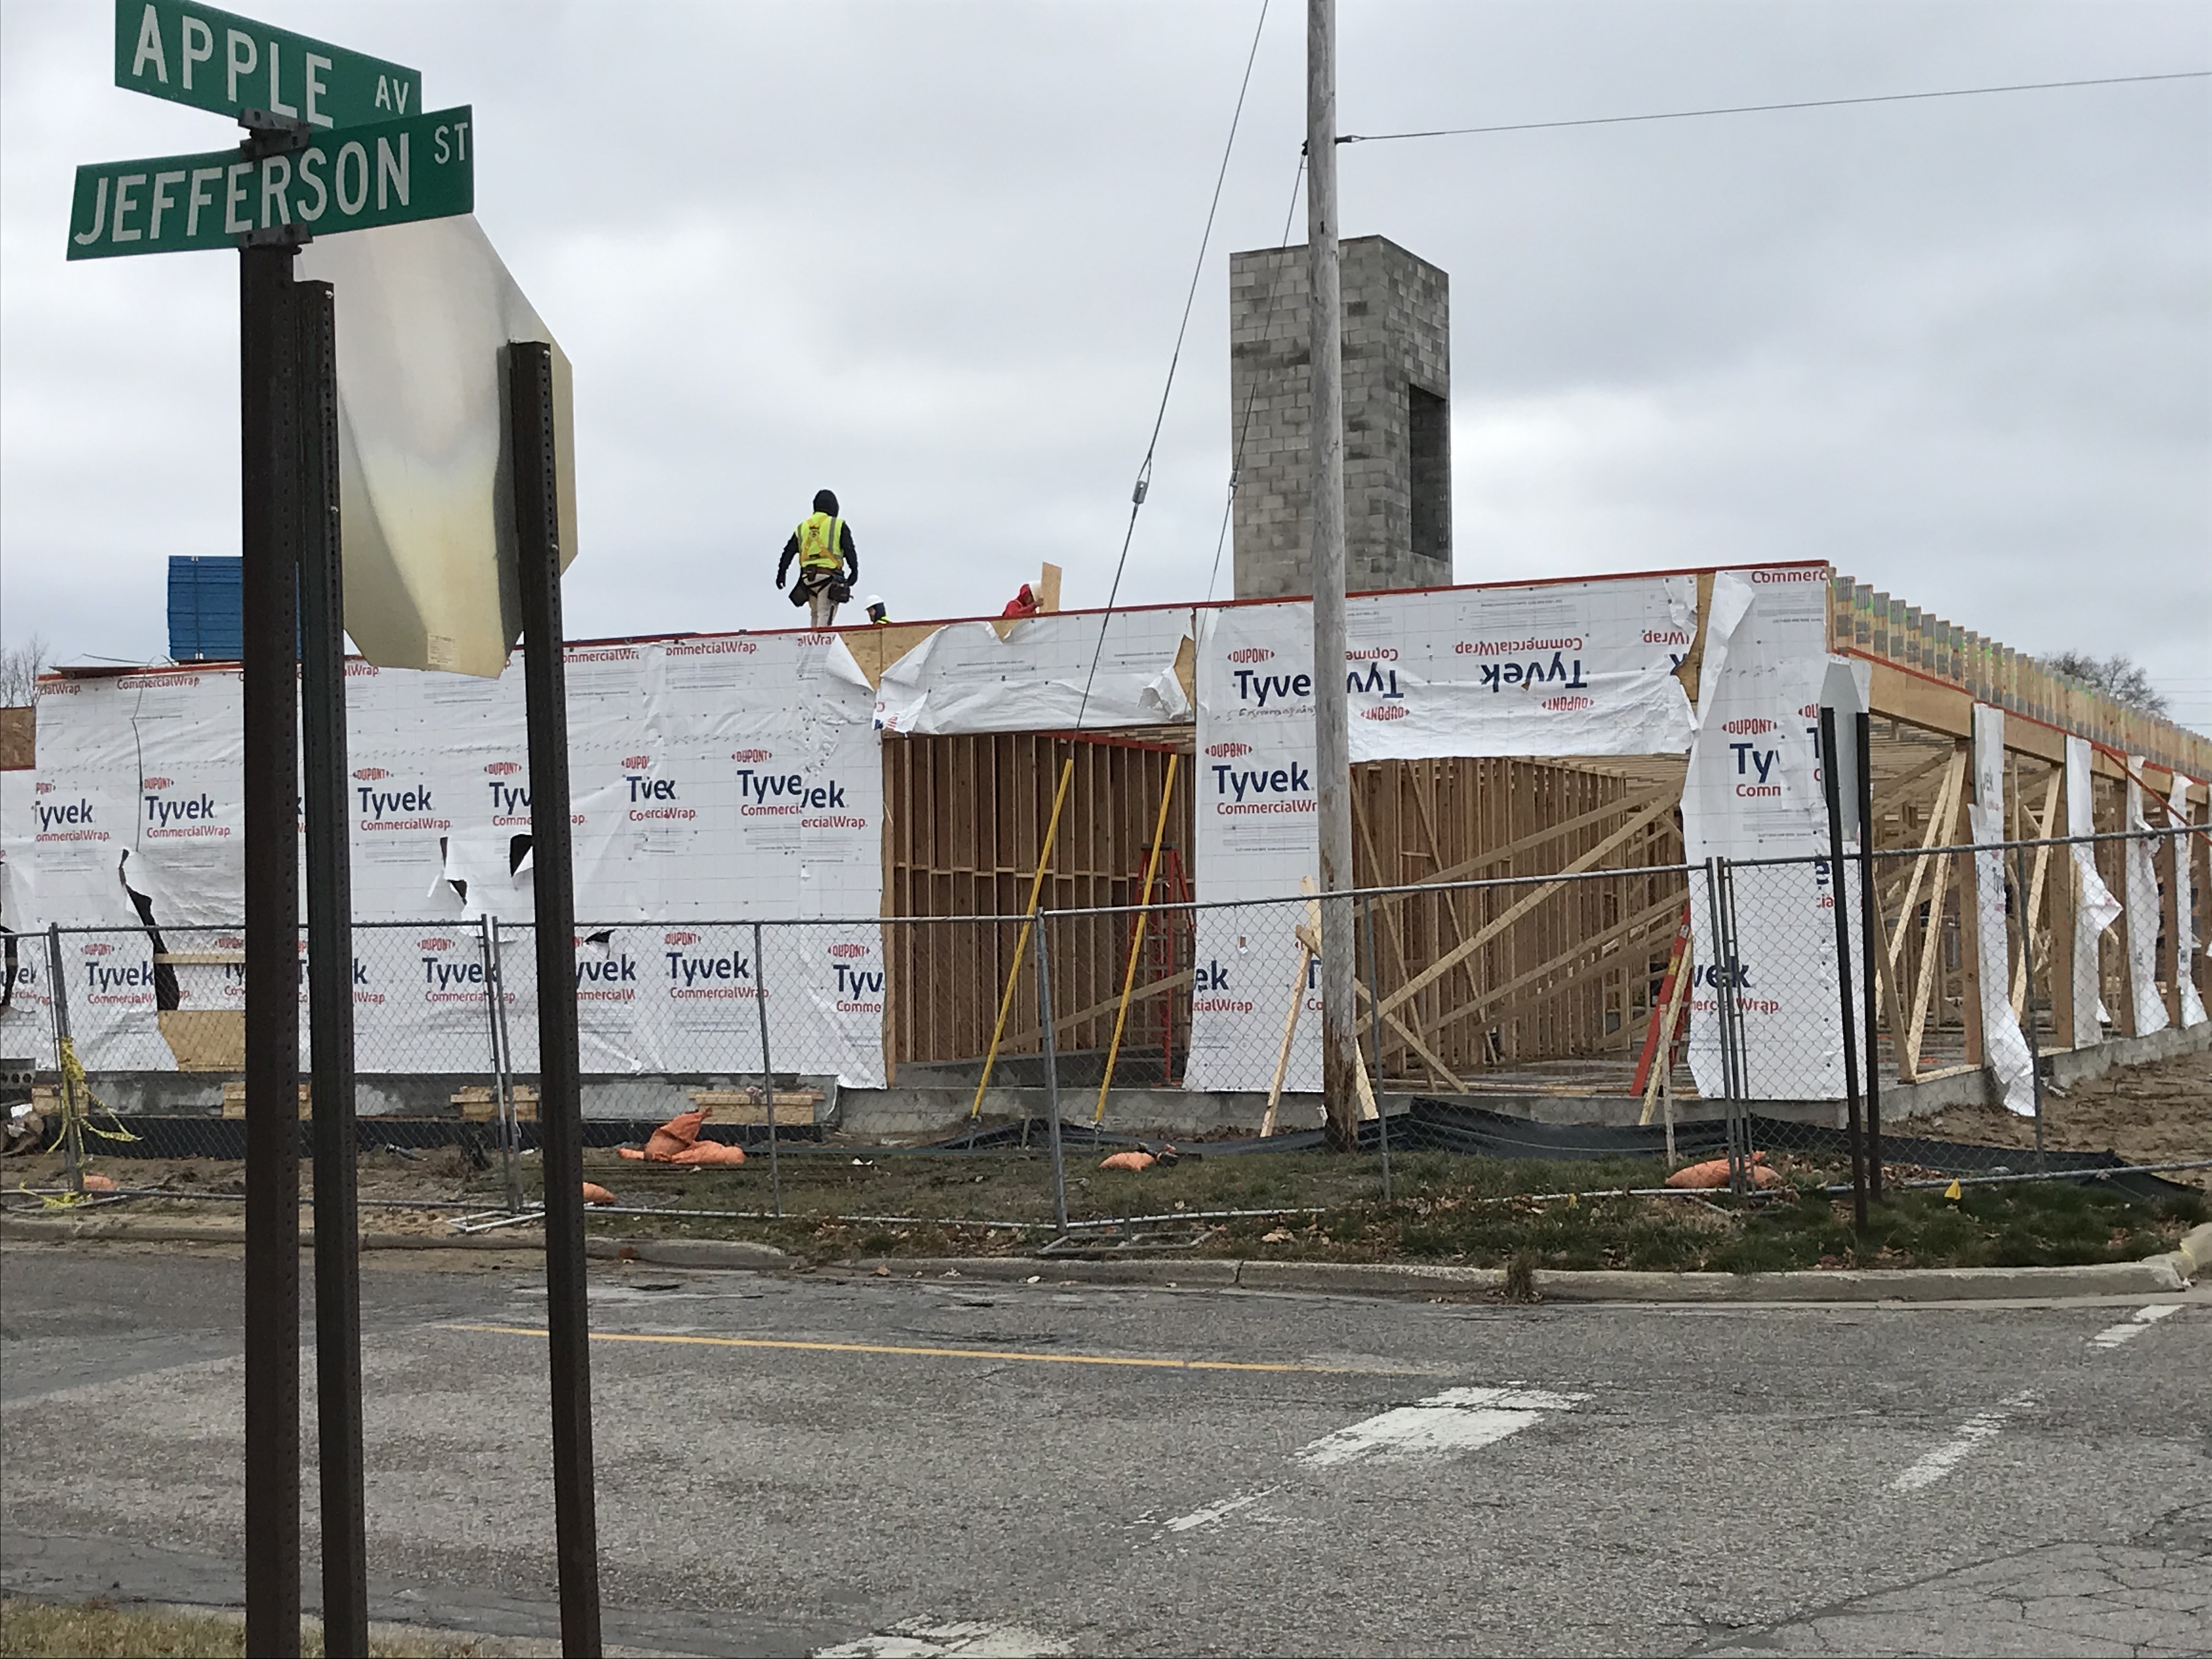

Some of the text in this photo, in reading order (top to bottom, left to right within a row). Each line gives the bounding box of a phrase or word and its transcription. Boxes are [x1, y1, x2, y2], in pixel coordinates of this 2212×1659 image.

[132, 3, 409, 129] APPLE AV
[74, 122, 469, 245] JEFFERSON ST
[665, 641, 757, 656] ommercialWrap
[1455, 637, 1583, 655] CommercialWrap
[1232, 648, 1270, 663] DUPONT
[1480, 652, 1587, 693] Tyvek
[117, 675, 200, 690] CommercialWrap
[1347, 662, 1404, 699] Tyv
[1234, 670, 1311, 707] Tyve
[1547, 696, 1588, 711] DUPONT
[1365, 706, 1404, 721] DUPONT
[1729, 719, 1773, 735] DUPONT
[736, 749, 768, 763] DUPONT
[1211, 743, 1248, 758] DUPONT
[488, 761, 519, 775] DUPONT
[626, 755, 647, 770] DUPO
[357, 768, 385, 781] DUPONT
[1212, 762, 1310, 802] Tyvek
[737, 770, 802, 804] Tyve
[358, 785, 432, 820] Tyvek
[489, 782, 531, 815] Tyv
[145, 793, 215, 828] Tyvek
[1217, 800, 1317, 815] CommercialWr
[360, 819, 450, 831] CommercialWrap
[802, 816, 866, 830] ercialWrap
[36, 830, 110, 842] ommercialWrap
[147, 825, 230, 838] CommercialWrap
[421, 938, 452, 951] DUPONT
[664, 932, 697, 945] DUPONT
[833, 944, 865, 958] DUPONT
[666, 951, 749, 987] Tyvek
[85, 961, 154, 994] Tyvek
[833, 964, 883, 1001] Tyv
